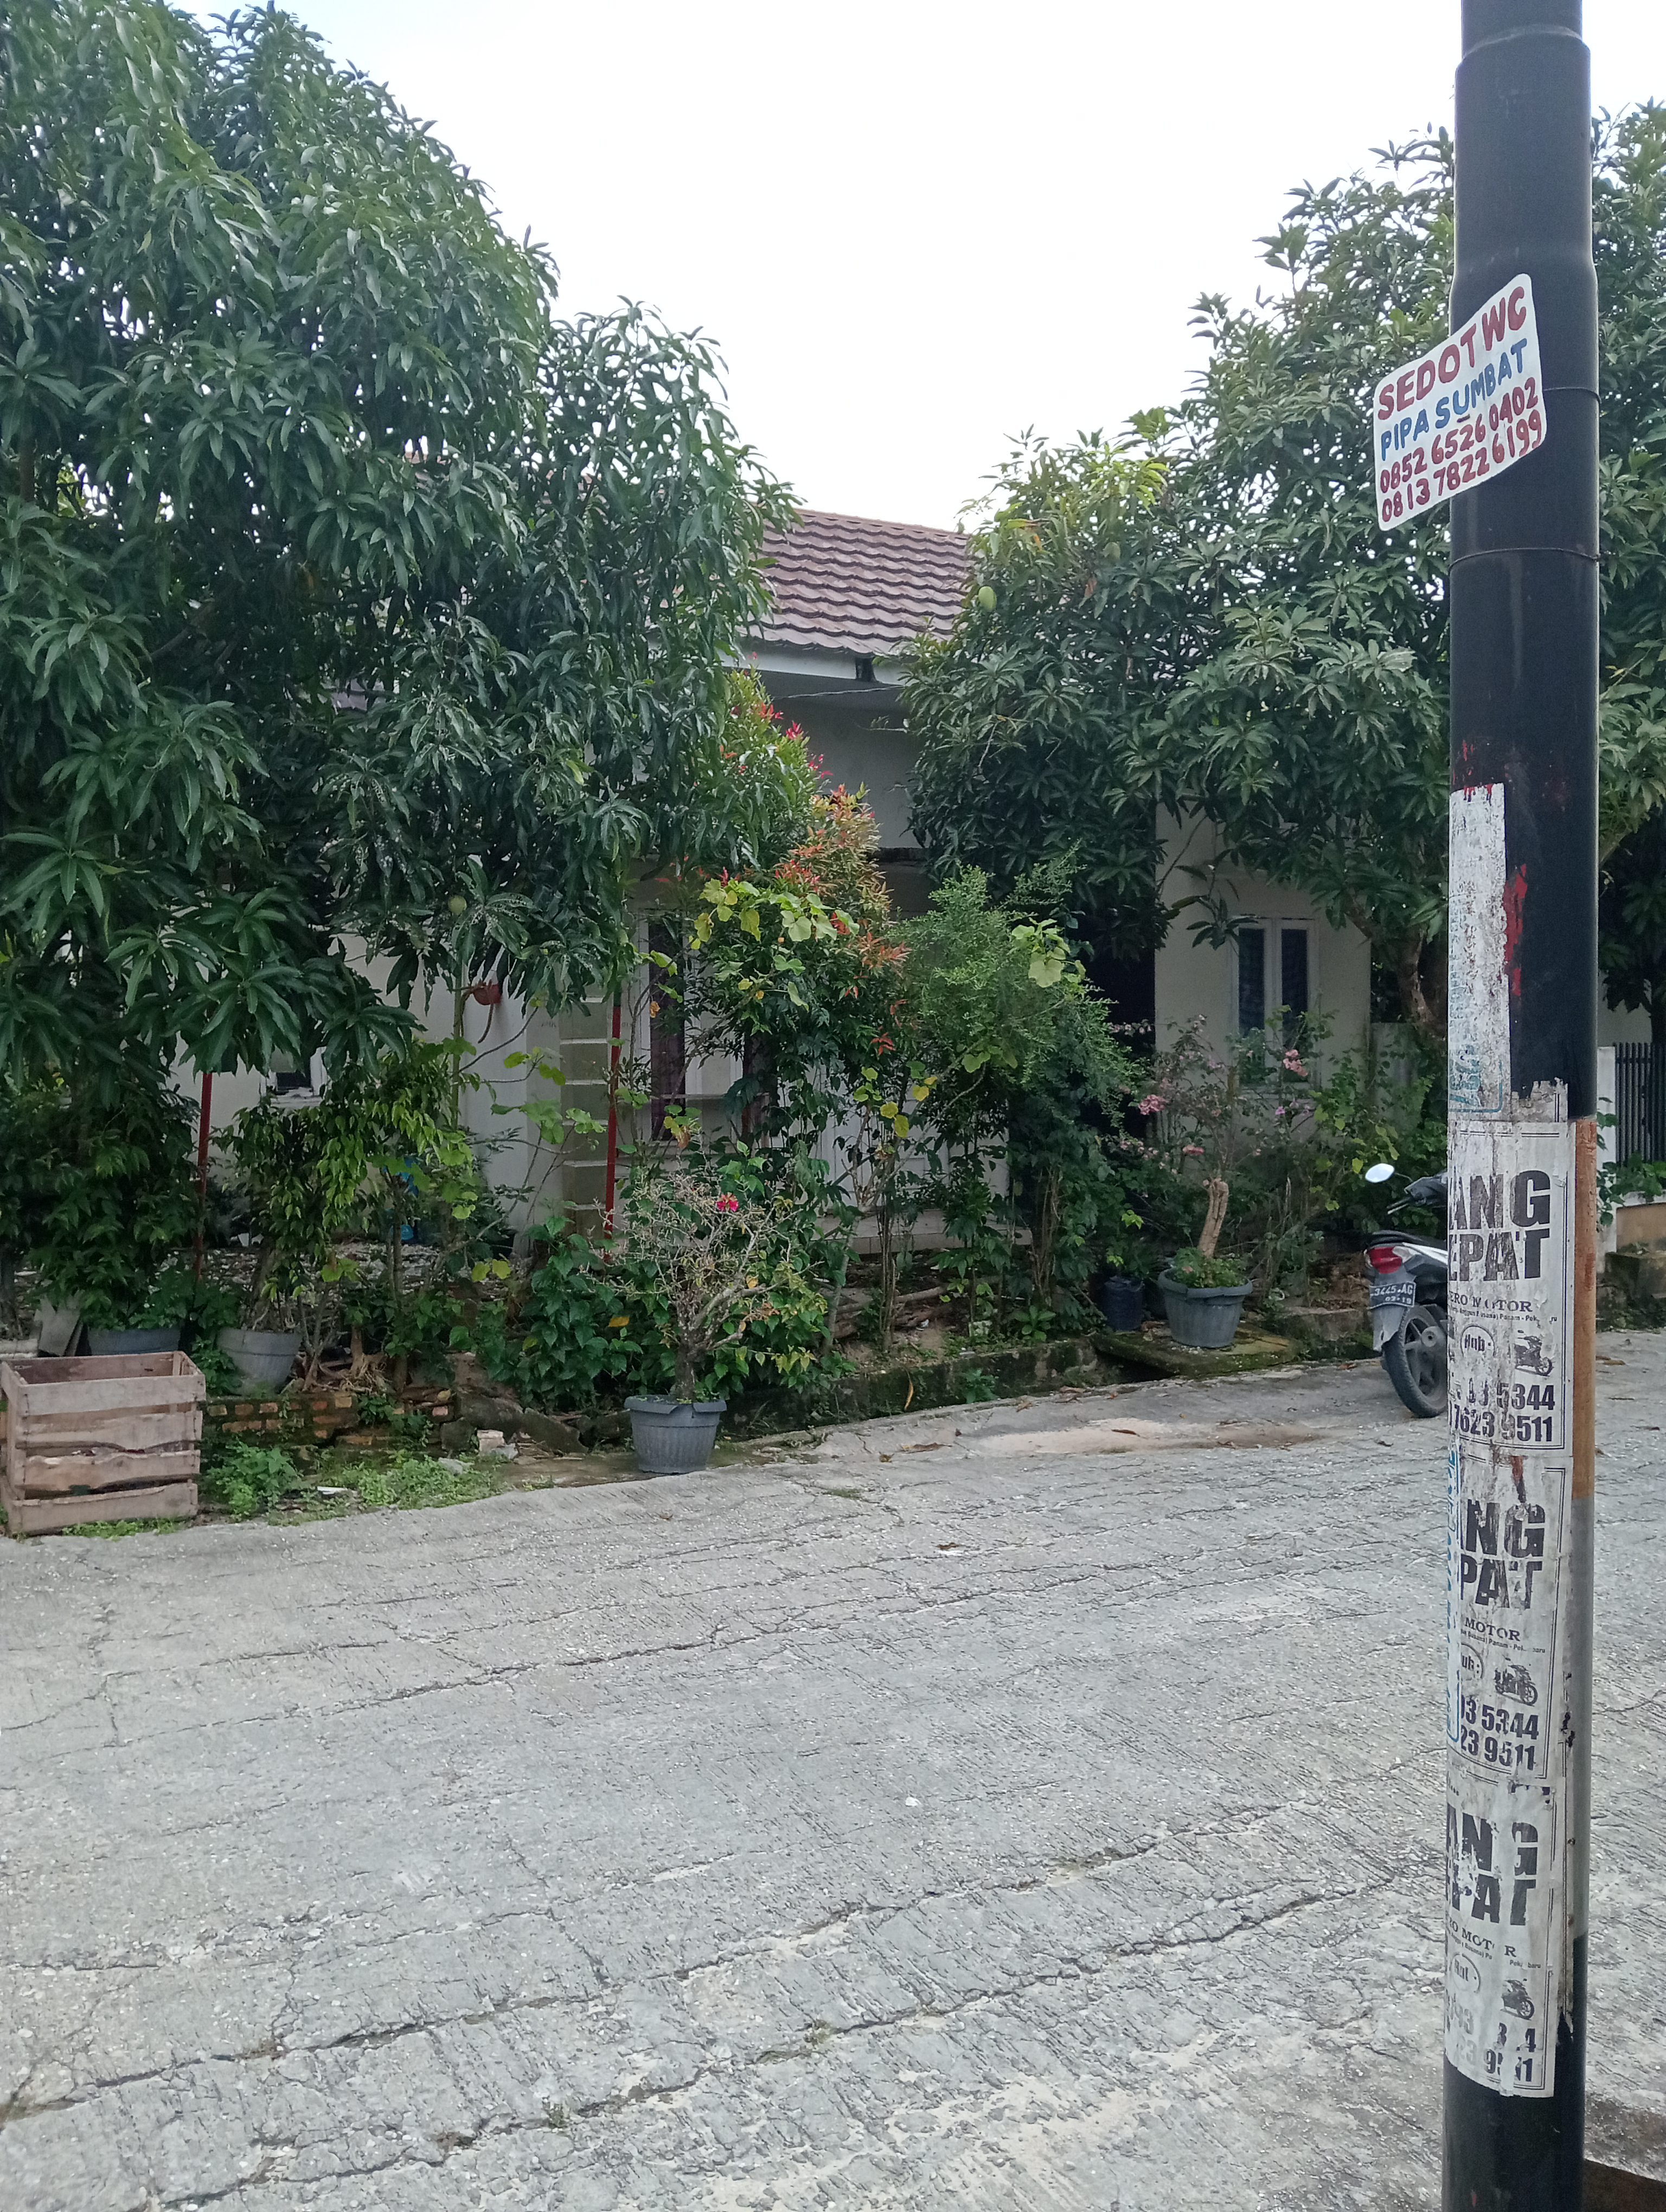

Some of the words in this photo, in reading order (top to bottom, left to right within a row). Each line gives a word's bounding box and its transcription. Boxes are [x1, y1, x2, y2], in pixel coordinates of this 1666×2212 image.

[1377, 323, 1477, 420] SEDOT
[1482, 286, 1527, 351] WC
[1381, 408, 1430, 461] PIPA
[1435, 337, 1528, 429] SUMBAT
[1380, 447, 1427, 493] 0852
[1431, 414, 1486, 465] 6526
[1489, 377, 1539, 432] 0402
[1382, 478, 1430, 523] 0813
[1433, 447, 1490, 497] 7822
[1491, 409, 1542, 464] 6199
[1497, 1382, 1555, 1410] 5344
[1501, 1413, 1552, 1442] 9511
[1465, 1617, 1521, 1642] MOTOR
[1482, 1704, 1539, 1740] 5344
[1484, 1737, 1536, 1771] 9511
[1462, 1927, 1517, 1958] MOTR
